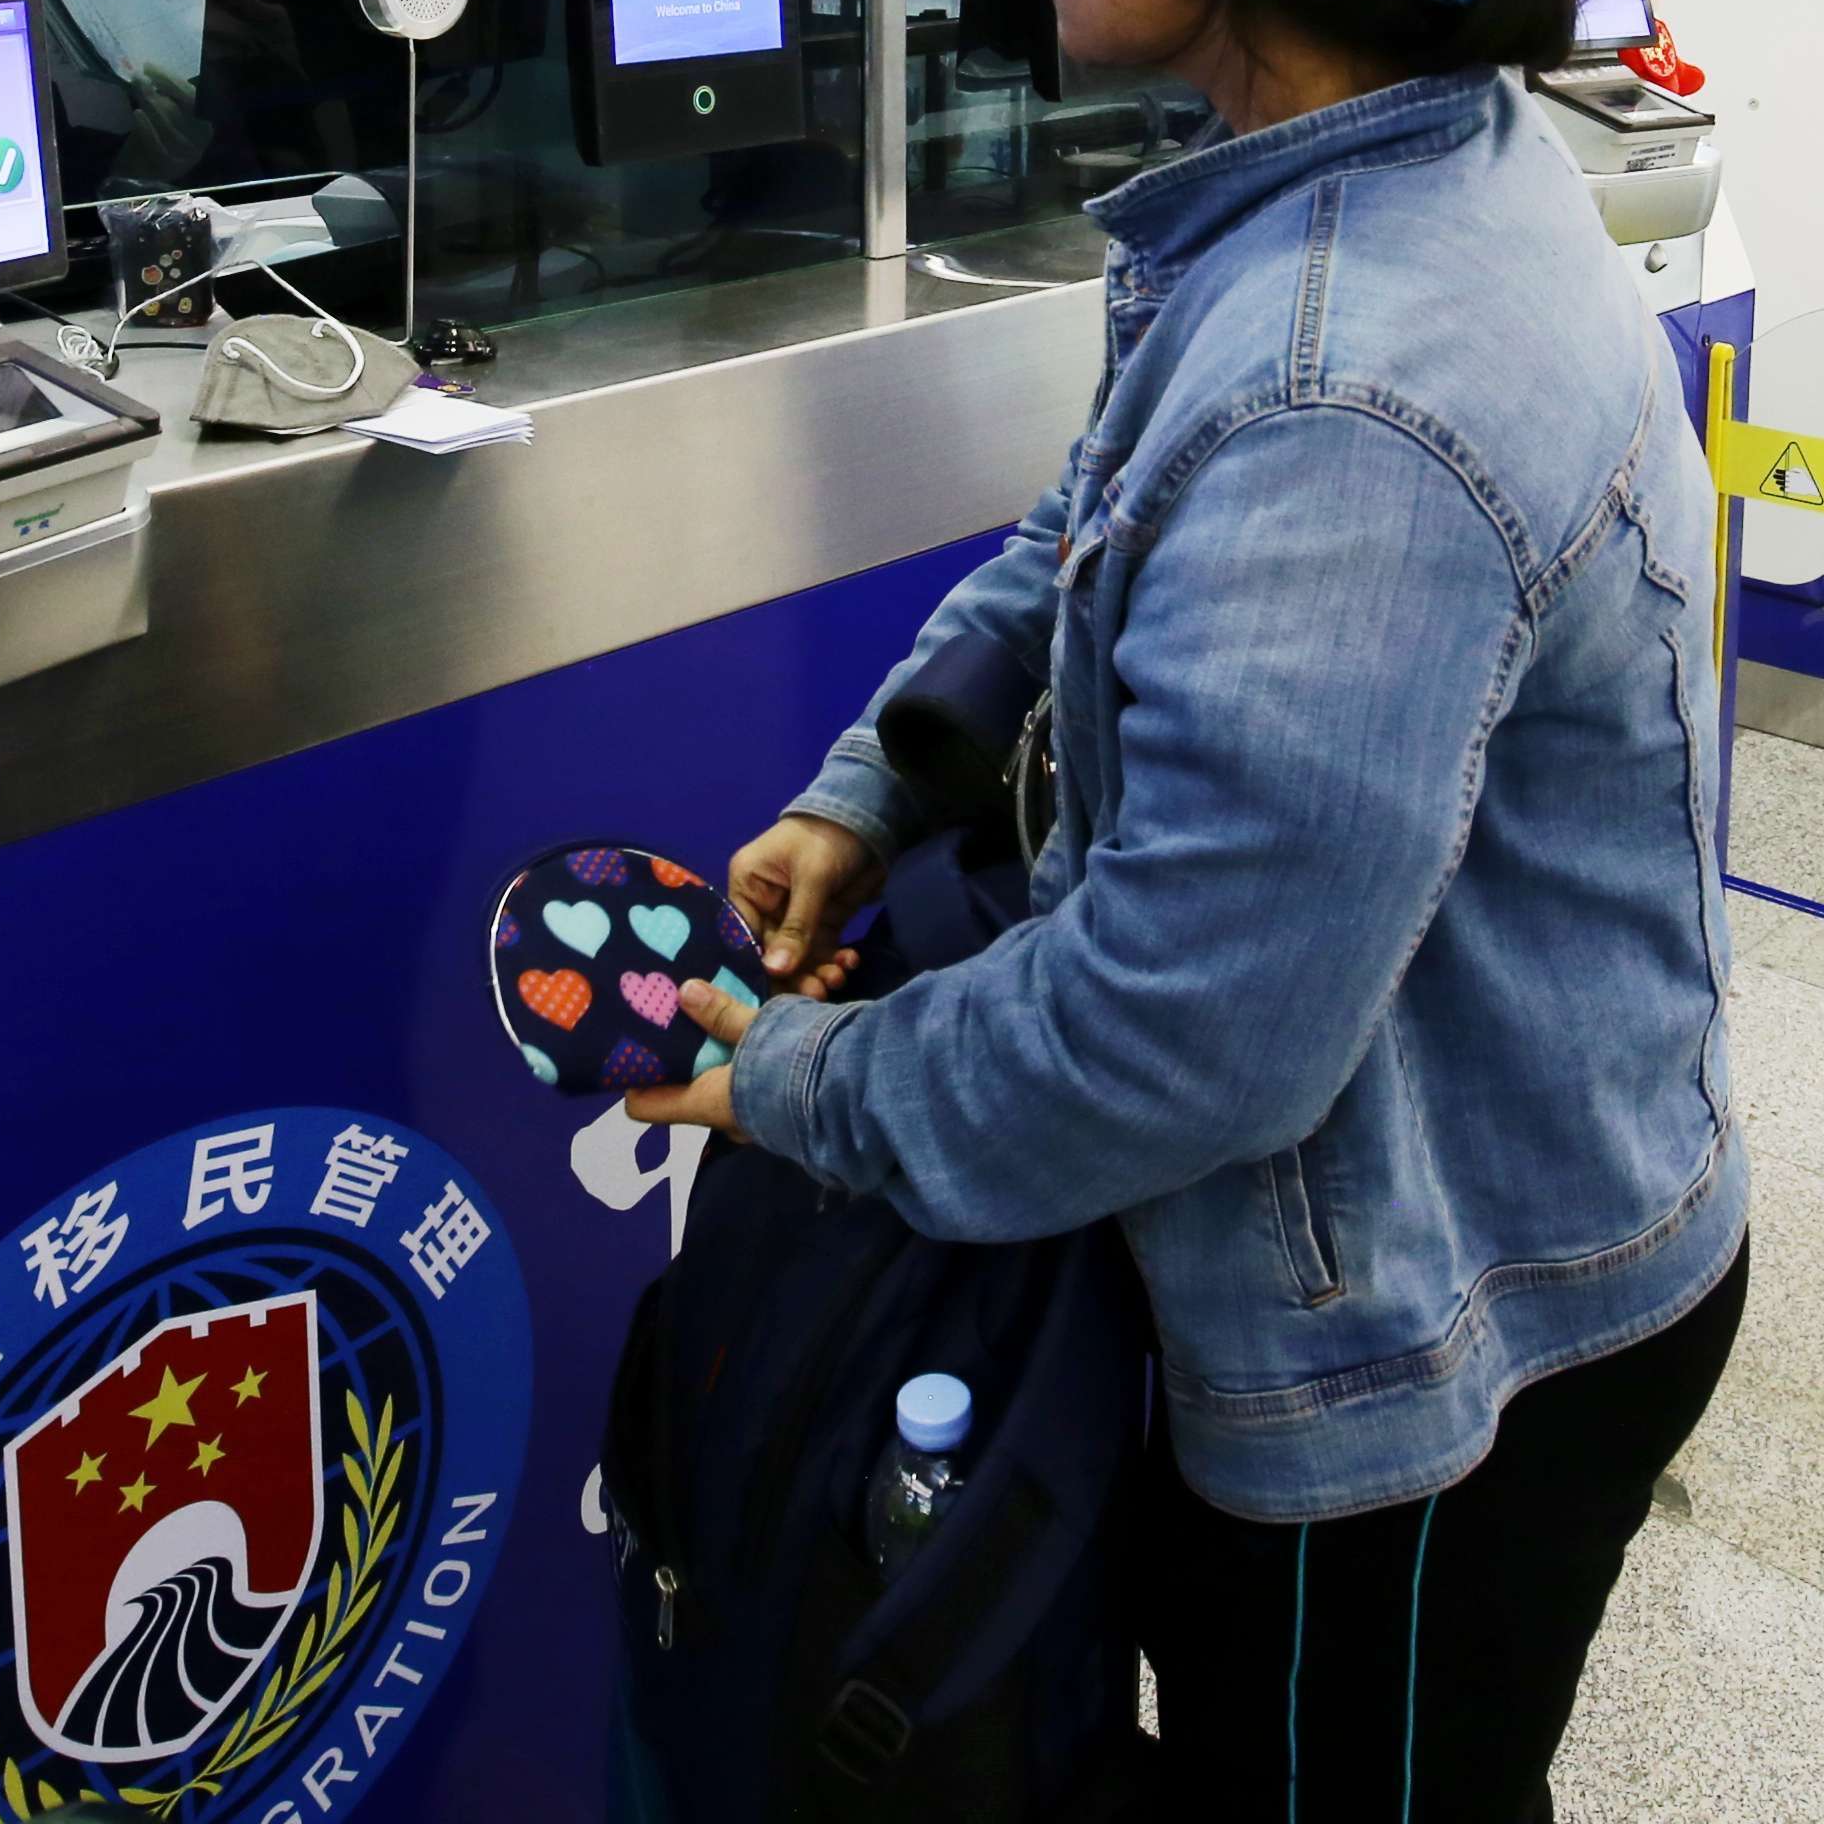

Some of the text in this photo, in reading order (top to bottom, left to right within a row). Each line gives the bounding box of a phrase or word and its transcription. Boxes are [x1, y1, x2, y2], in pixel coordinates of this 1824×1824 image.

[655, 0, 741, 18] Welcome to China
